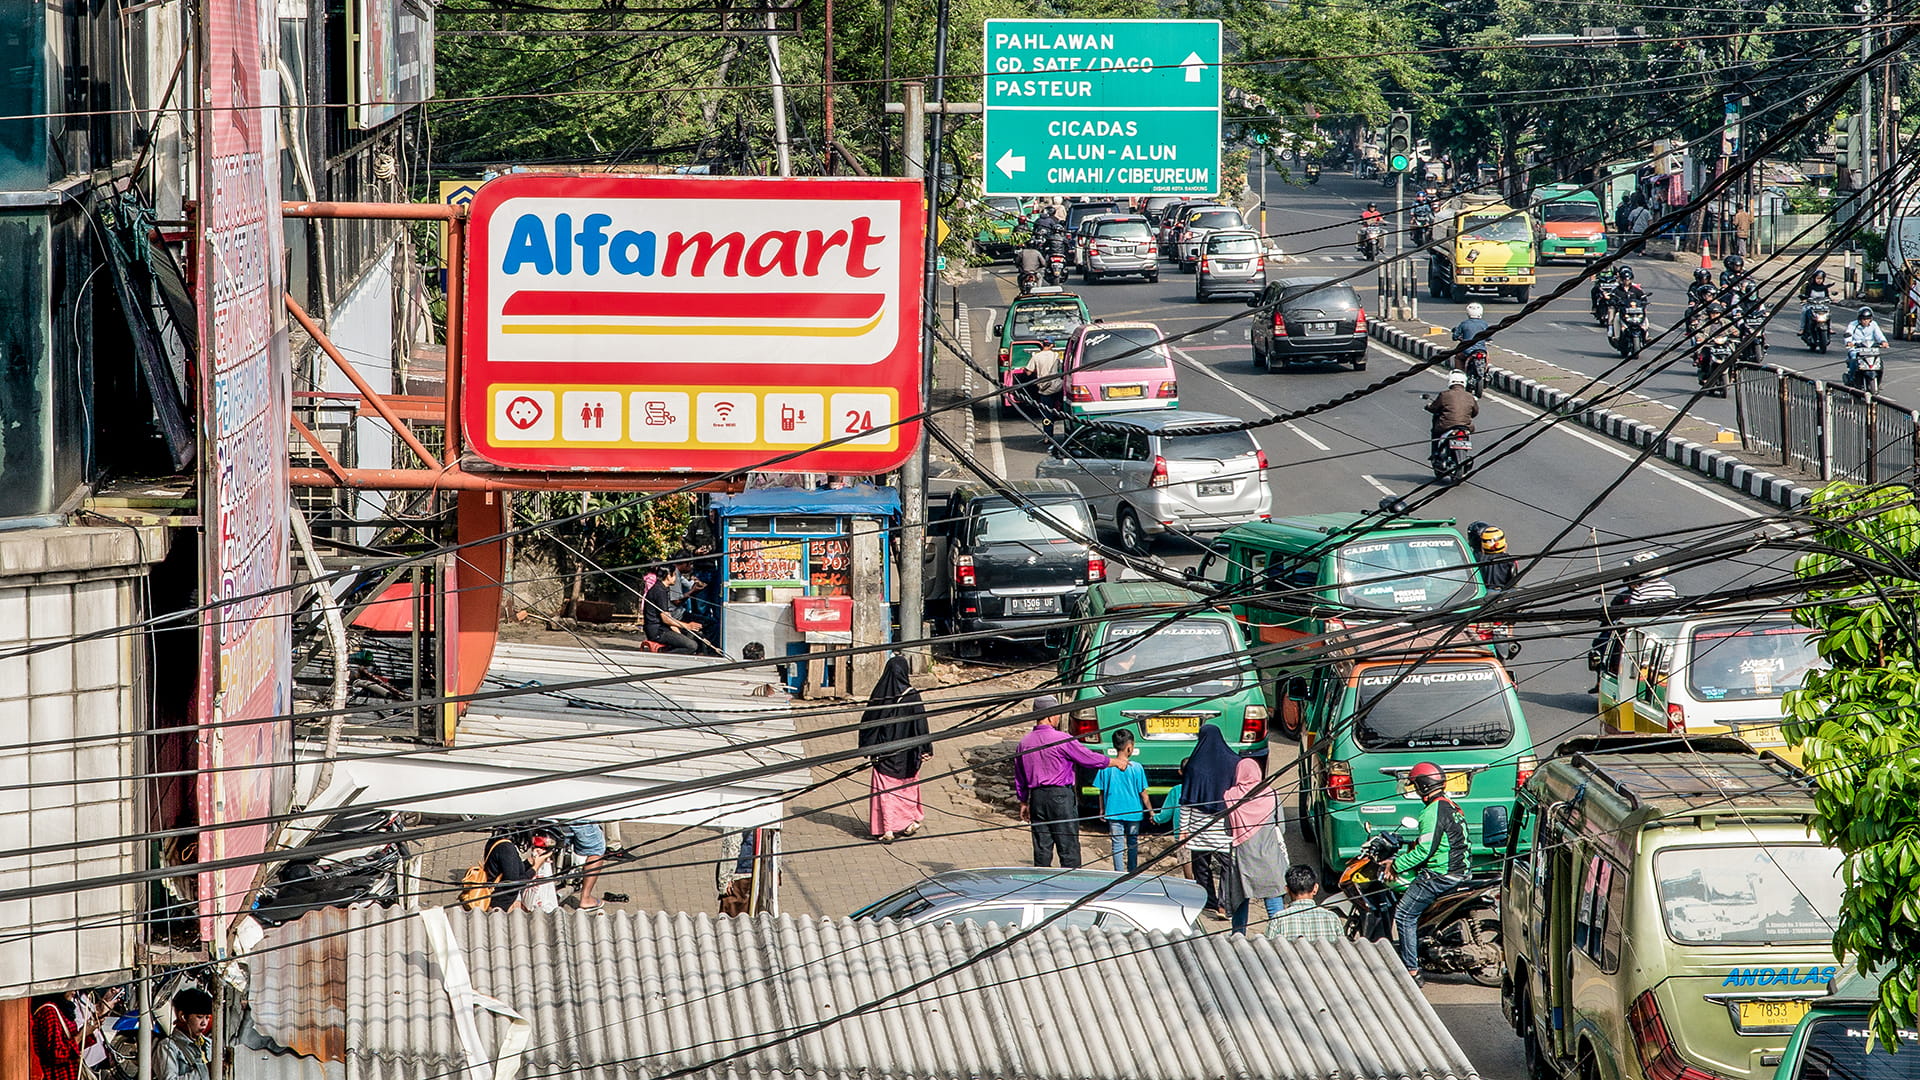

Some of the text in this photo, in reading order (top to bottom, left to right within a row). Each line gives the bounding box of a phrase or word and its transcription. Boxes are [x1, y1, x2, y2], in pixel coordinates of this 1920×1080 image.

[995, 34, 1114, 50] PAHLAWAN
[995, 57, 1026, 73] GD.
[995, 81, 1092, 97] PASTEUR
[1048, 121, 1138, 137] CICADAS
[502, 212, 885, 279] Alfamart
[845, 409, 873, 434] 24
[1343, 540, 1455, 556] CAHEUM CIROYOM
[730, 560, 797, 573] BASO TAHU
[1023, 598, 1041, 608] 1506
[1430, 671, 1494, 684] CIROYOM
[1721, 966, 1837, 987] ANDALAS
[1742, 1004, 1749, 1018] Z
[1758, 1003, 1788, 1017] 7853
